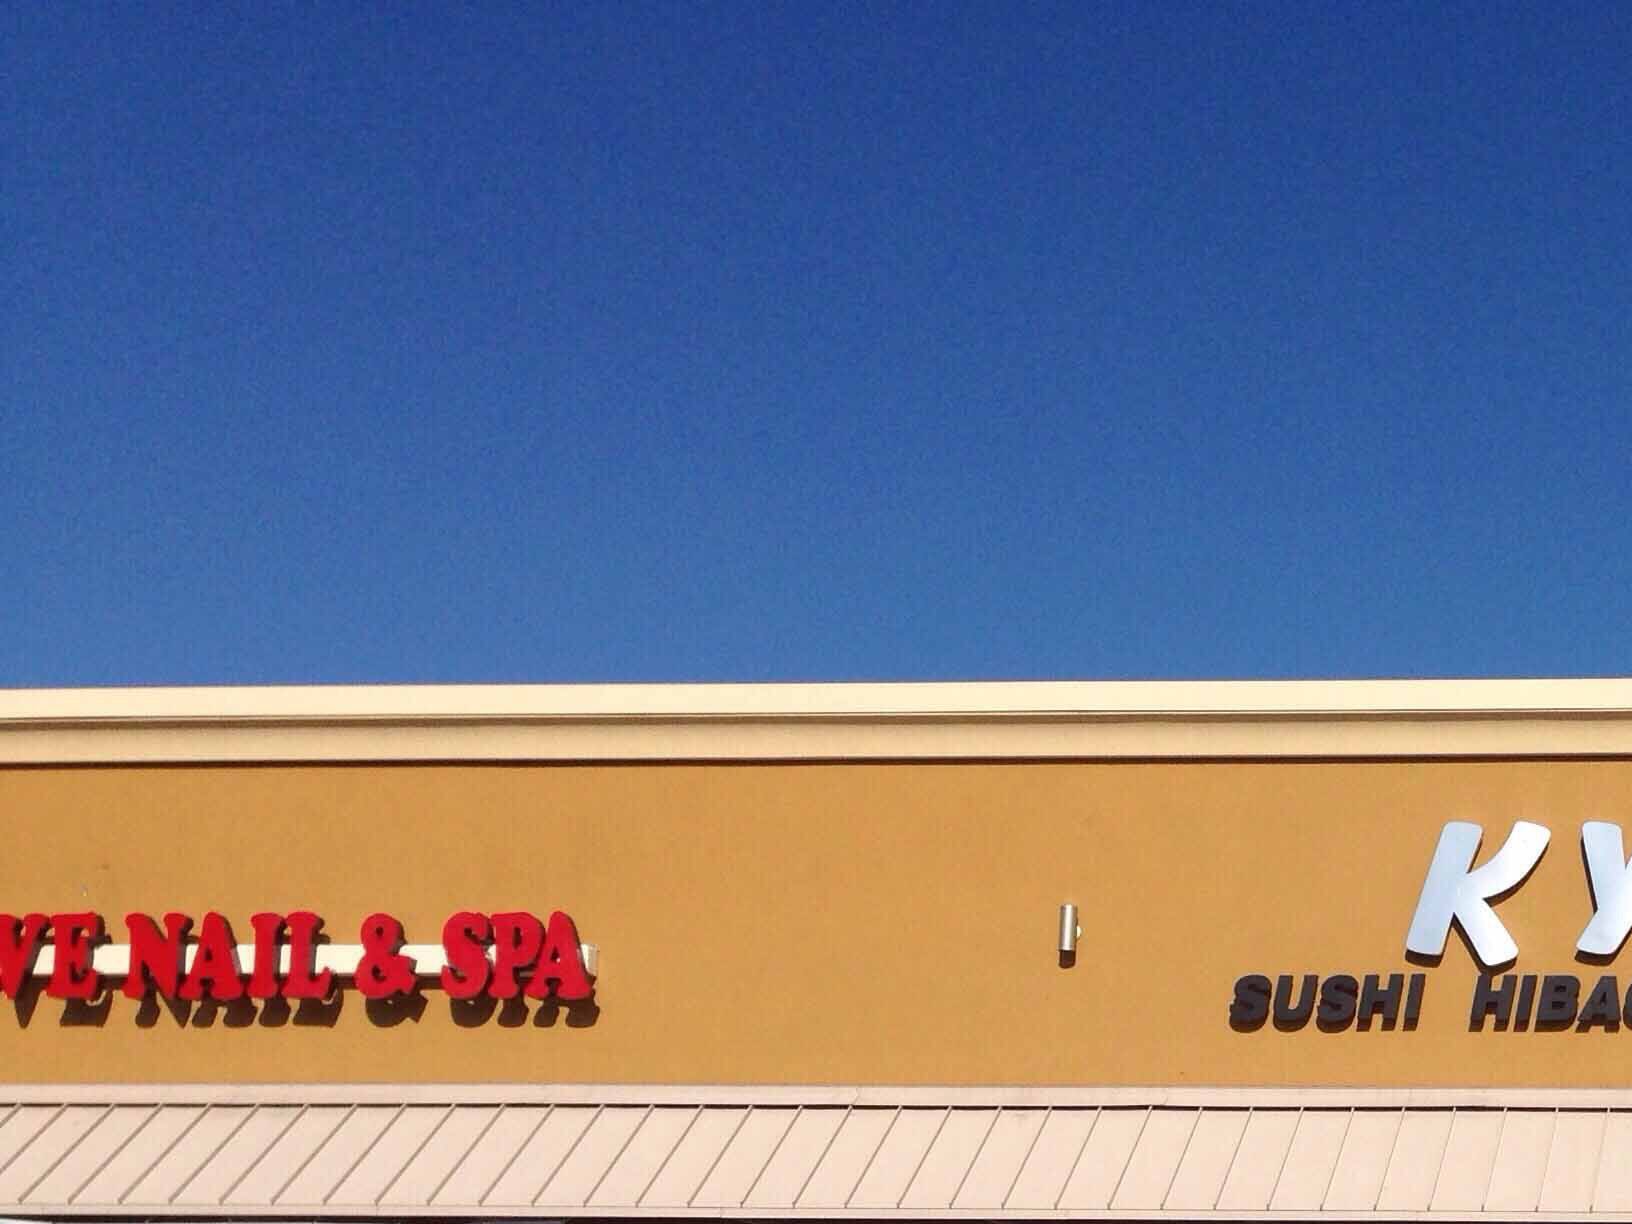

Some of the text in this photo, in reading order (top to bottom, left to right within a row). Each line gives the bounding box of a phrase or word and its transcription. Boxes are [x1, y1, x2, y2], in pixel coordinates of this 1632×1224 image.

[124, 911, 333, 999] NAIL
[354, 912, 417, 999] &
[440, 910, 592, 999] SPA
[1229, 973, 1426, 1031] SUSHI
